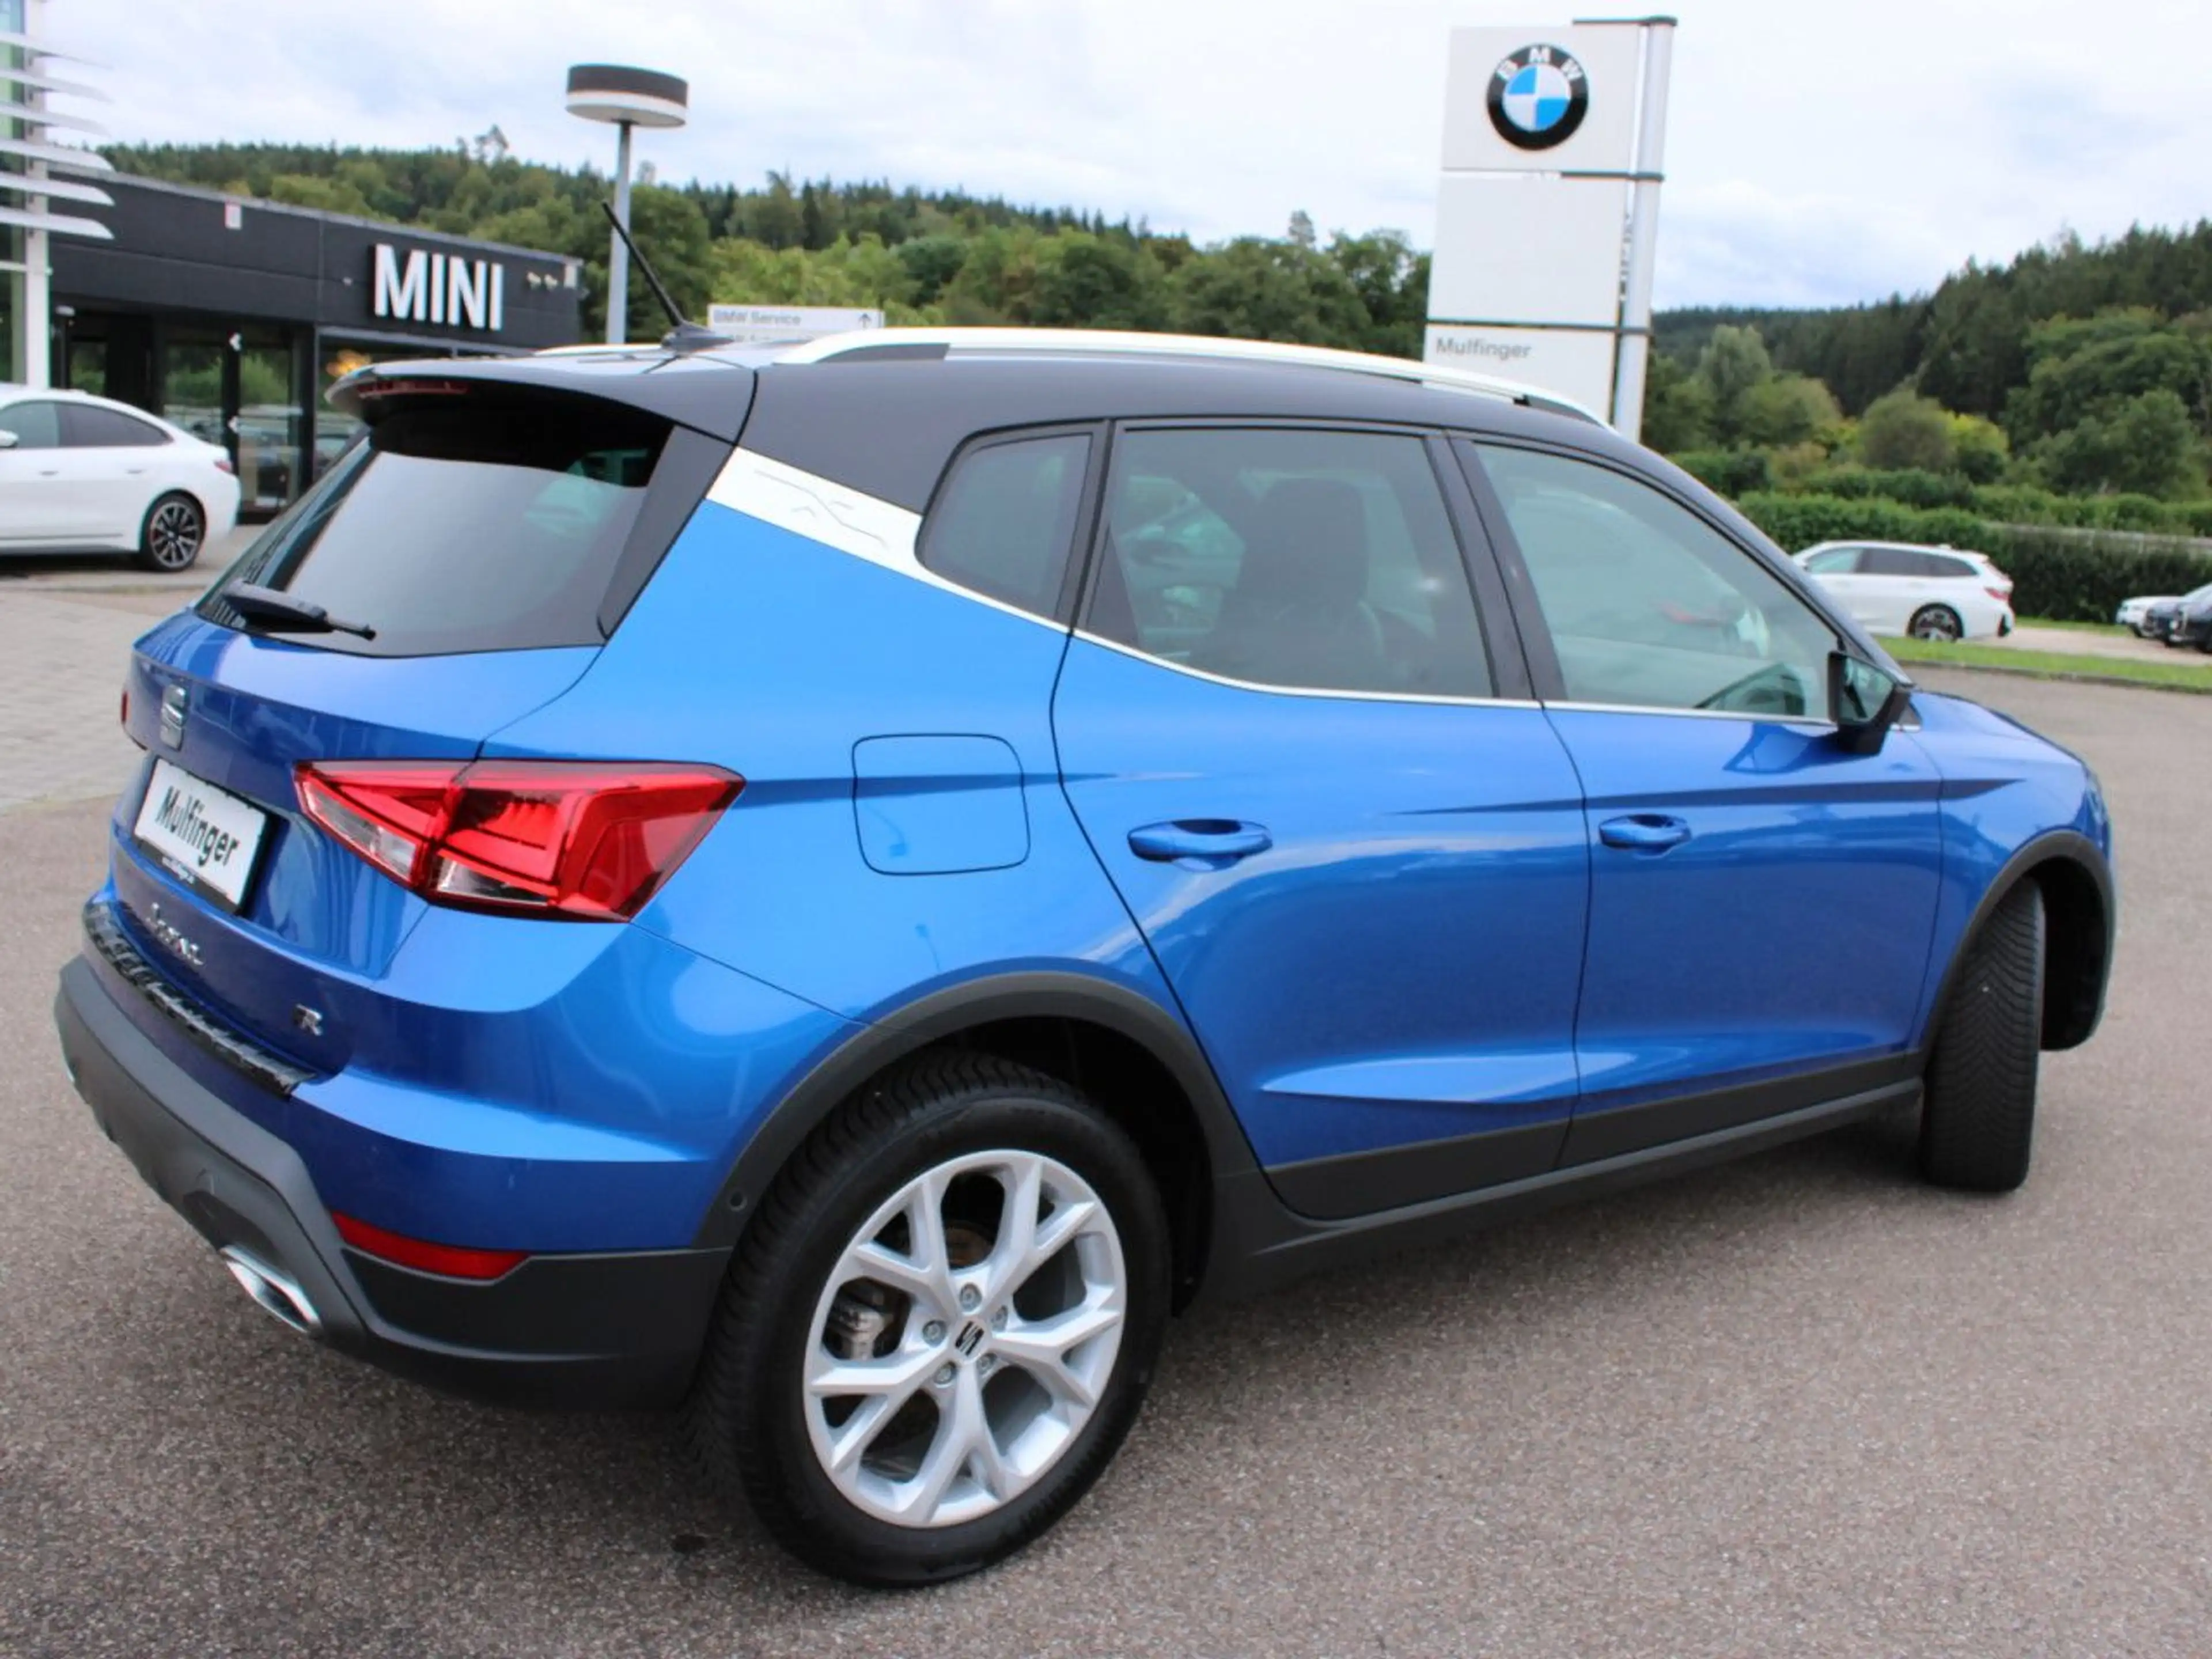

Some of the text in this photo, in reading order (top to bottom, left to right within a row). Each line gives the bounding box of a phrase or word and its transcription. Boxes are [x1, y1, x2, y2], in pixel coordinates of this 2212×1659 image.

[1497, 46, 1584, 81] BMW
[374, 243, 505, 332] MINI
[1436, 337, 1533, 361] Mulfinger
[154, 785, 241, 868] Mulfinger
